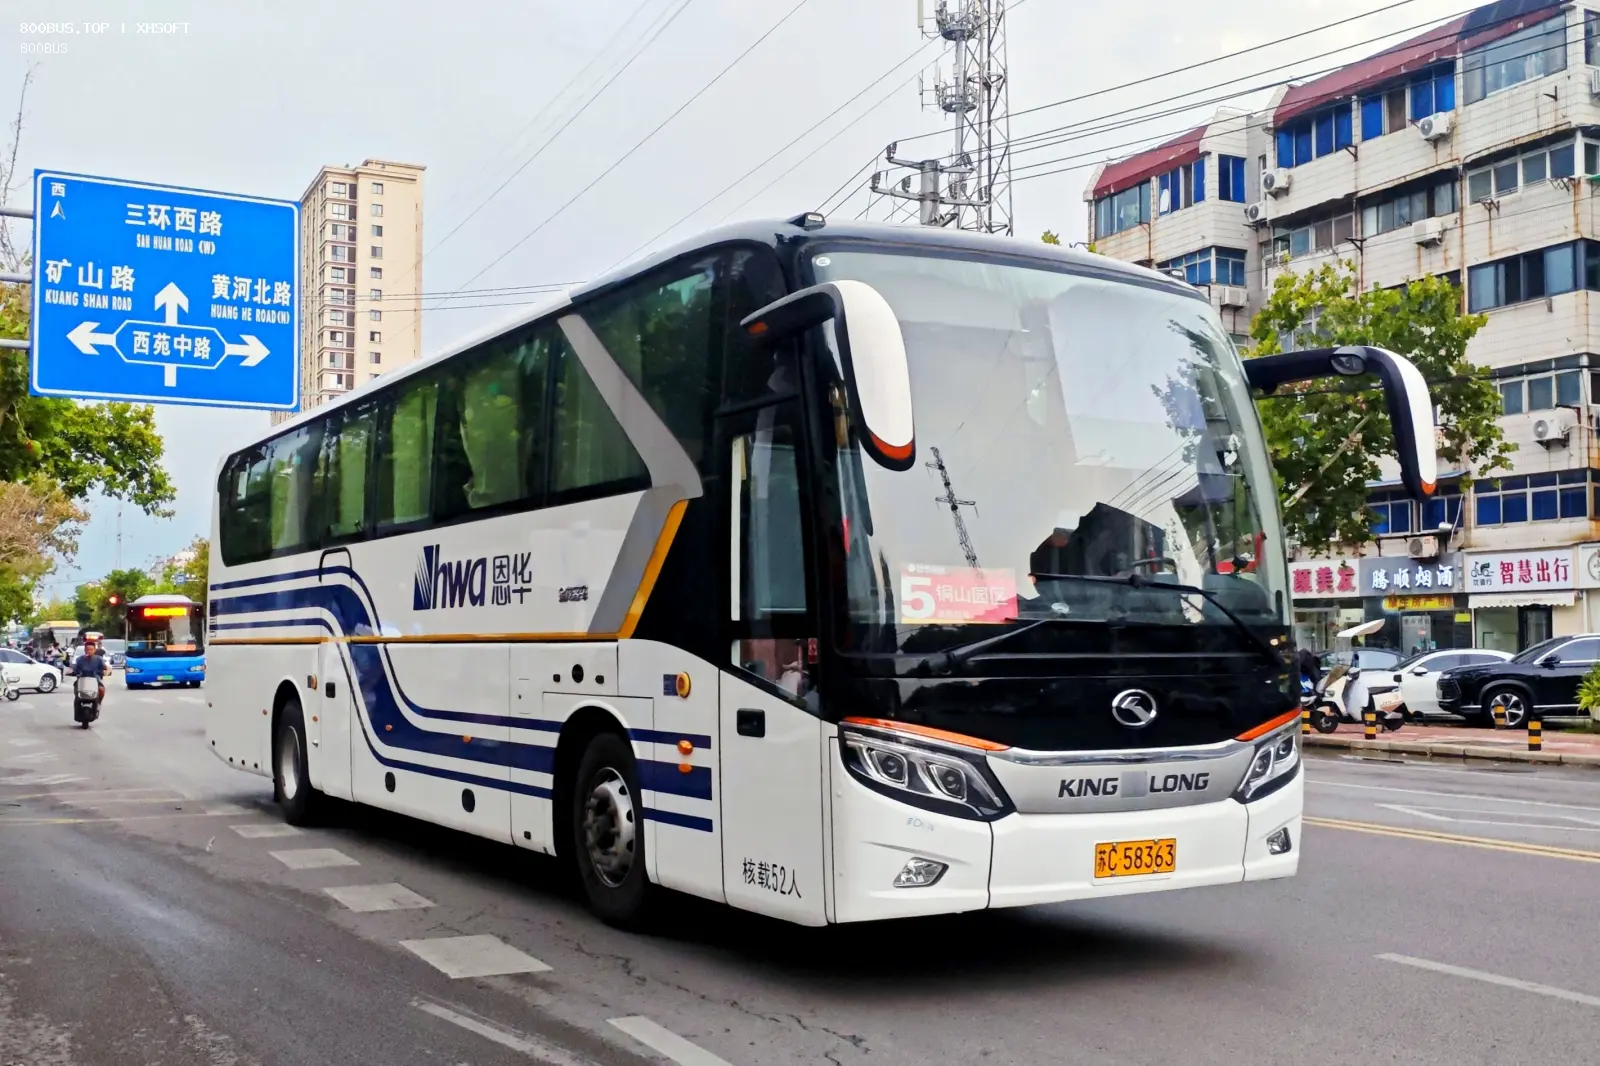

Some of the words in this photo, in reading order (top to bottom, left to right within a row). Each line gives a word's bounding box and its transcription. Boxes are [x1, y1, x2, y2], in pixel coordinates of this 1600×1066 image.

[50, 182, 66, 198] 西
[124, 203, 224, 237] 三环西路
[136, 233, 150, 249] SAN
[153, 236, 173, 251] HUAN
[175, 238, 194, 253] ROAD
[45, 258, 137, 292] 矿山路
[45, 289, 79, 307] KUANG
[83, 293, 109, 310] SHAN
[112, 296, 133, 312] ROAD
[211, 273, 292, 307] 黄河北路
[210, 303, 239, 321] HUANG
[241, 307, 253, 321] HE
[132, 330, 212, 360] 西苑中路
[1371, 563, 1455, 591] 腾顺烟酒
[1499, 557, 1570, 586] 智慧出行
[900, 576, 935, 619] 5
[1057, 777, 1119, 798] KING
[1149, 772, 1210, 793] LONG
[742, 857, 802, 899] 核载52人
